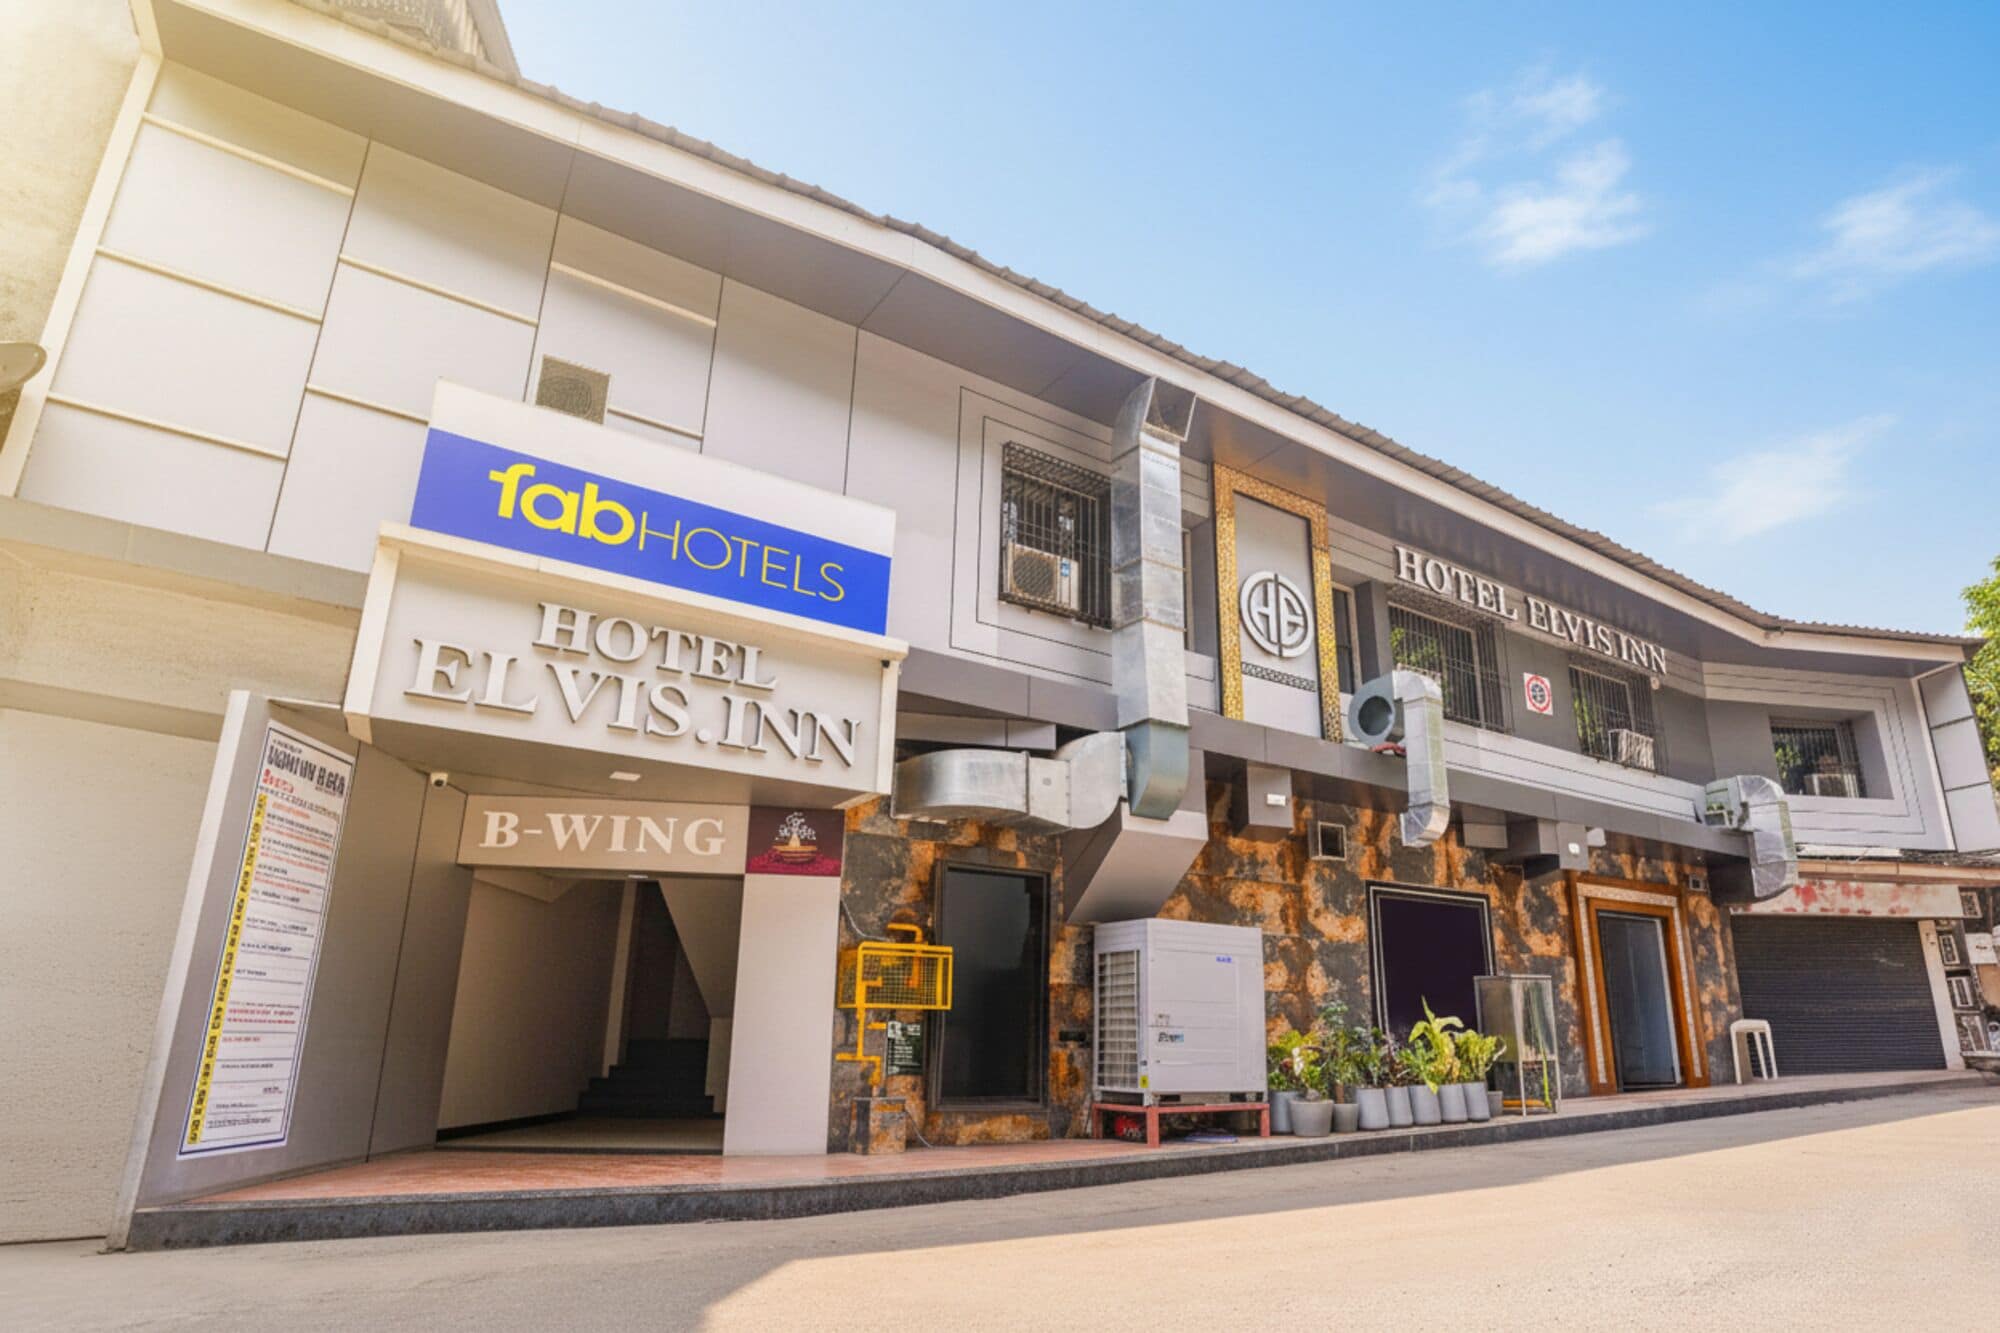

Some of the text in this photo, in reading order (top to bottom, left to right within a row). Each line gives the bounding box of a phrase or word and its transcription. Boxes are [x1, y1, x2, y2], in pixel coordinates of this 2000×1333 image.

[1394, 546, 1518, 621] HOTEL
[532, 602, 779, 691] HOTEL
[479, 810, 726, 856] B-WING
